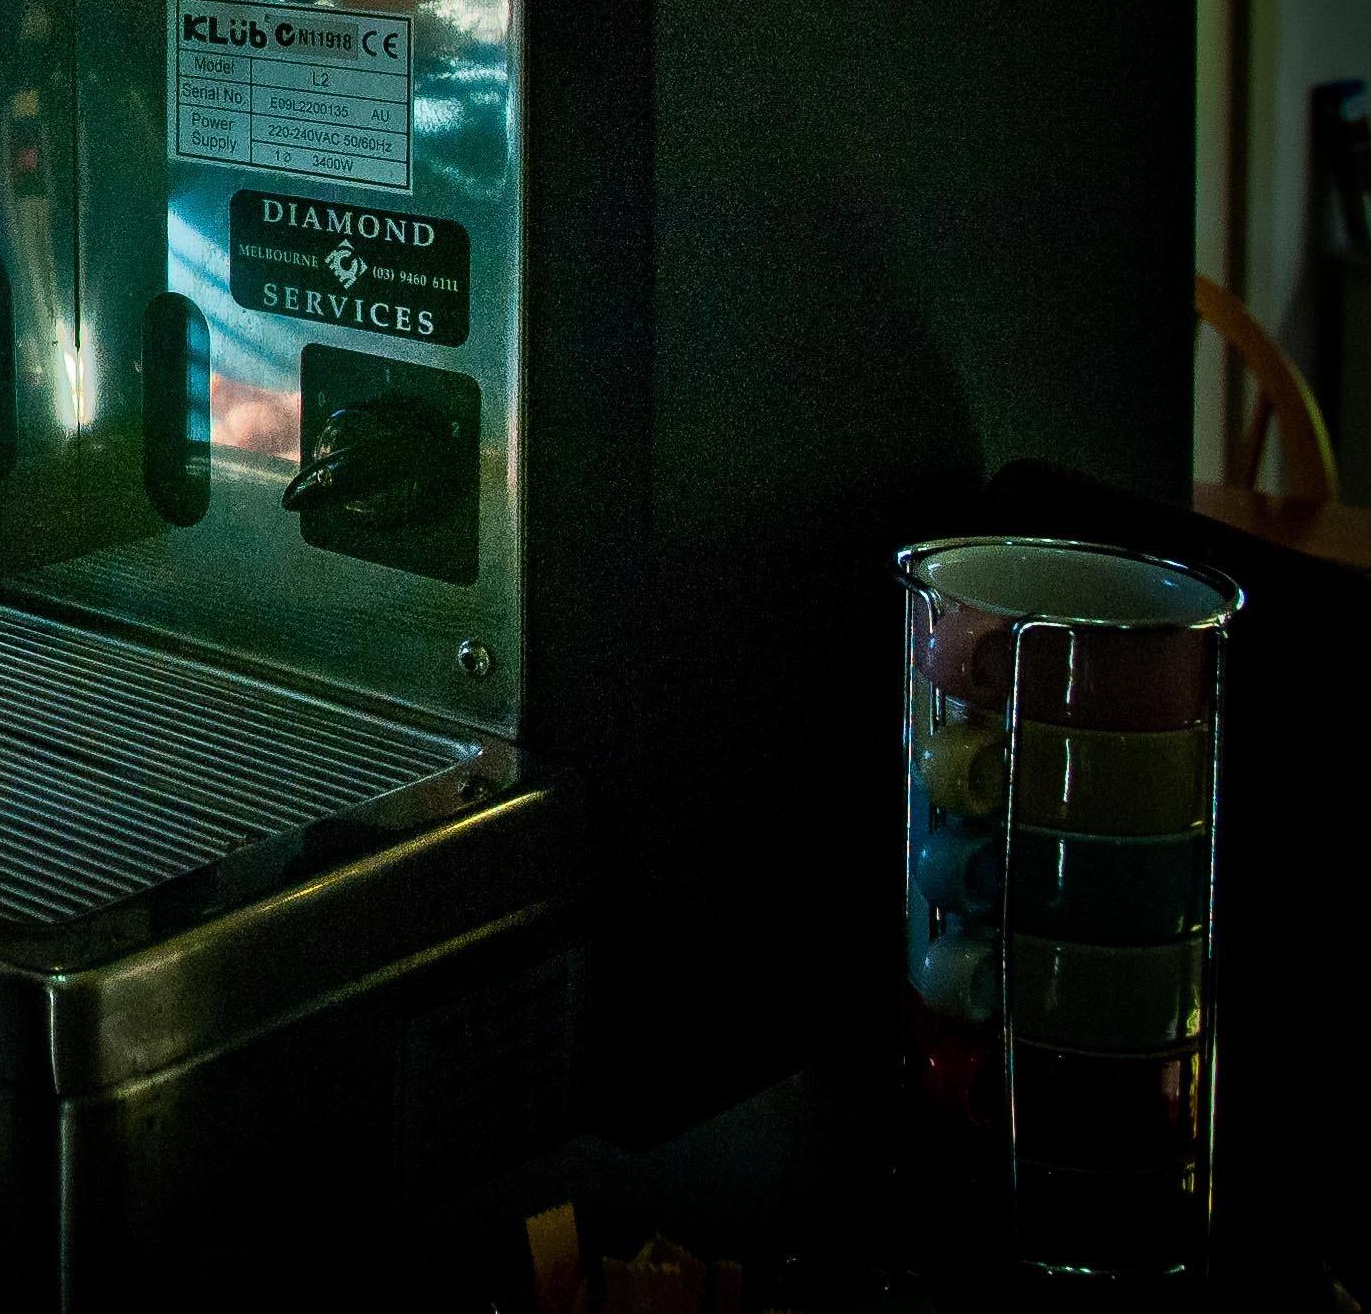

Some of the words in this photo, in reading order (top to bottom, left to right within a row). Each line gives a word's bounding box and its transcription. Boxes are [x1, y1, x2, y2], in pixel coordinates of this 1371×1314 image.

[298, 27, 353, 52] N11918
[194, 56, 234, 75] Model
[311, 71, 330, 87] L2
[181, 82, 220, 101] Serial
[191, 112, 236, 132] Power
[370, 108, 391, 123] AU
[190, 131, 238, 154] Supply
[267, 124, 341, 147] 220-240VAC
[343, 134, 394, 154] 50/60Hz
[312, 154, 354, 173] 3400W
[262, 199, 435, 247] DIAMOND
[238, 243, 320, 269] MELBOURNE
[263, 282, 435, 336] SERVICES
